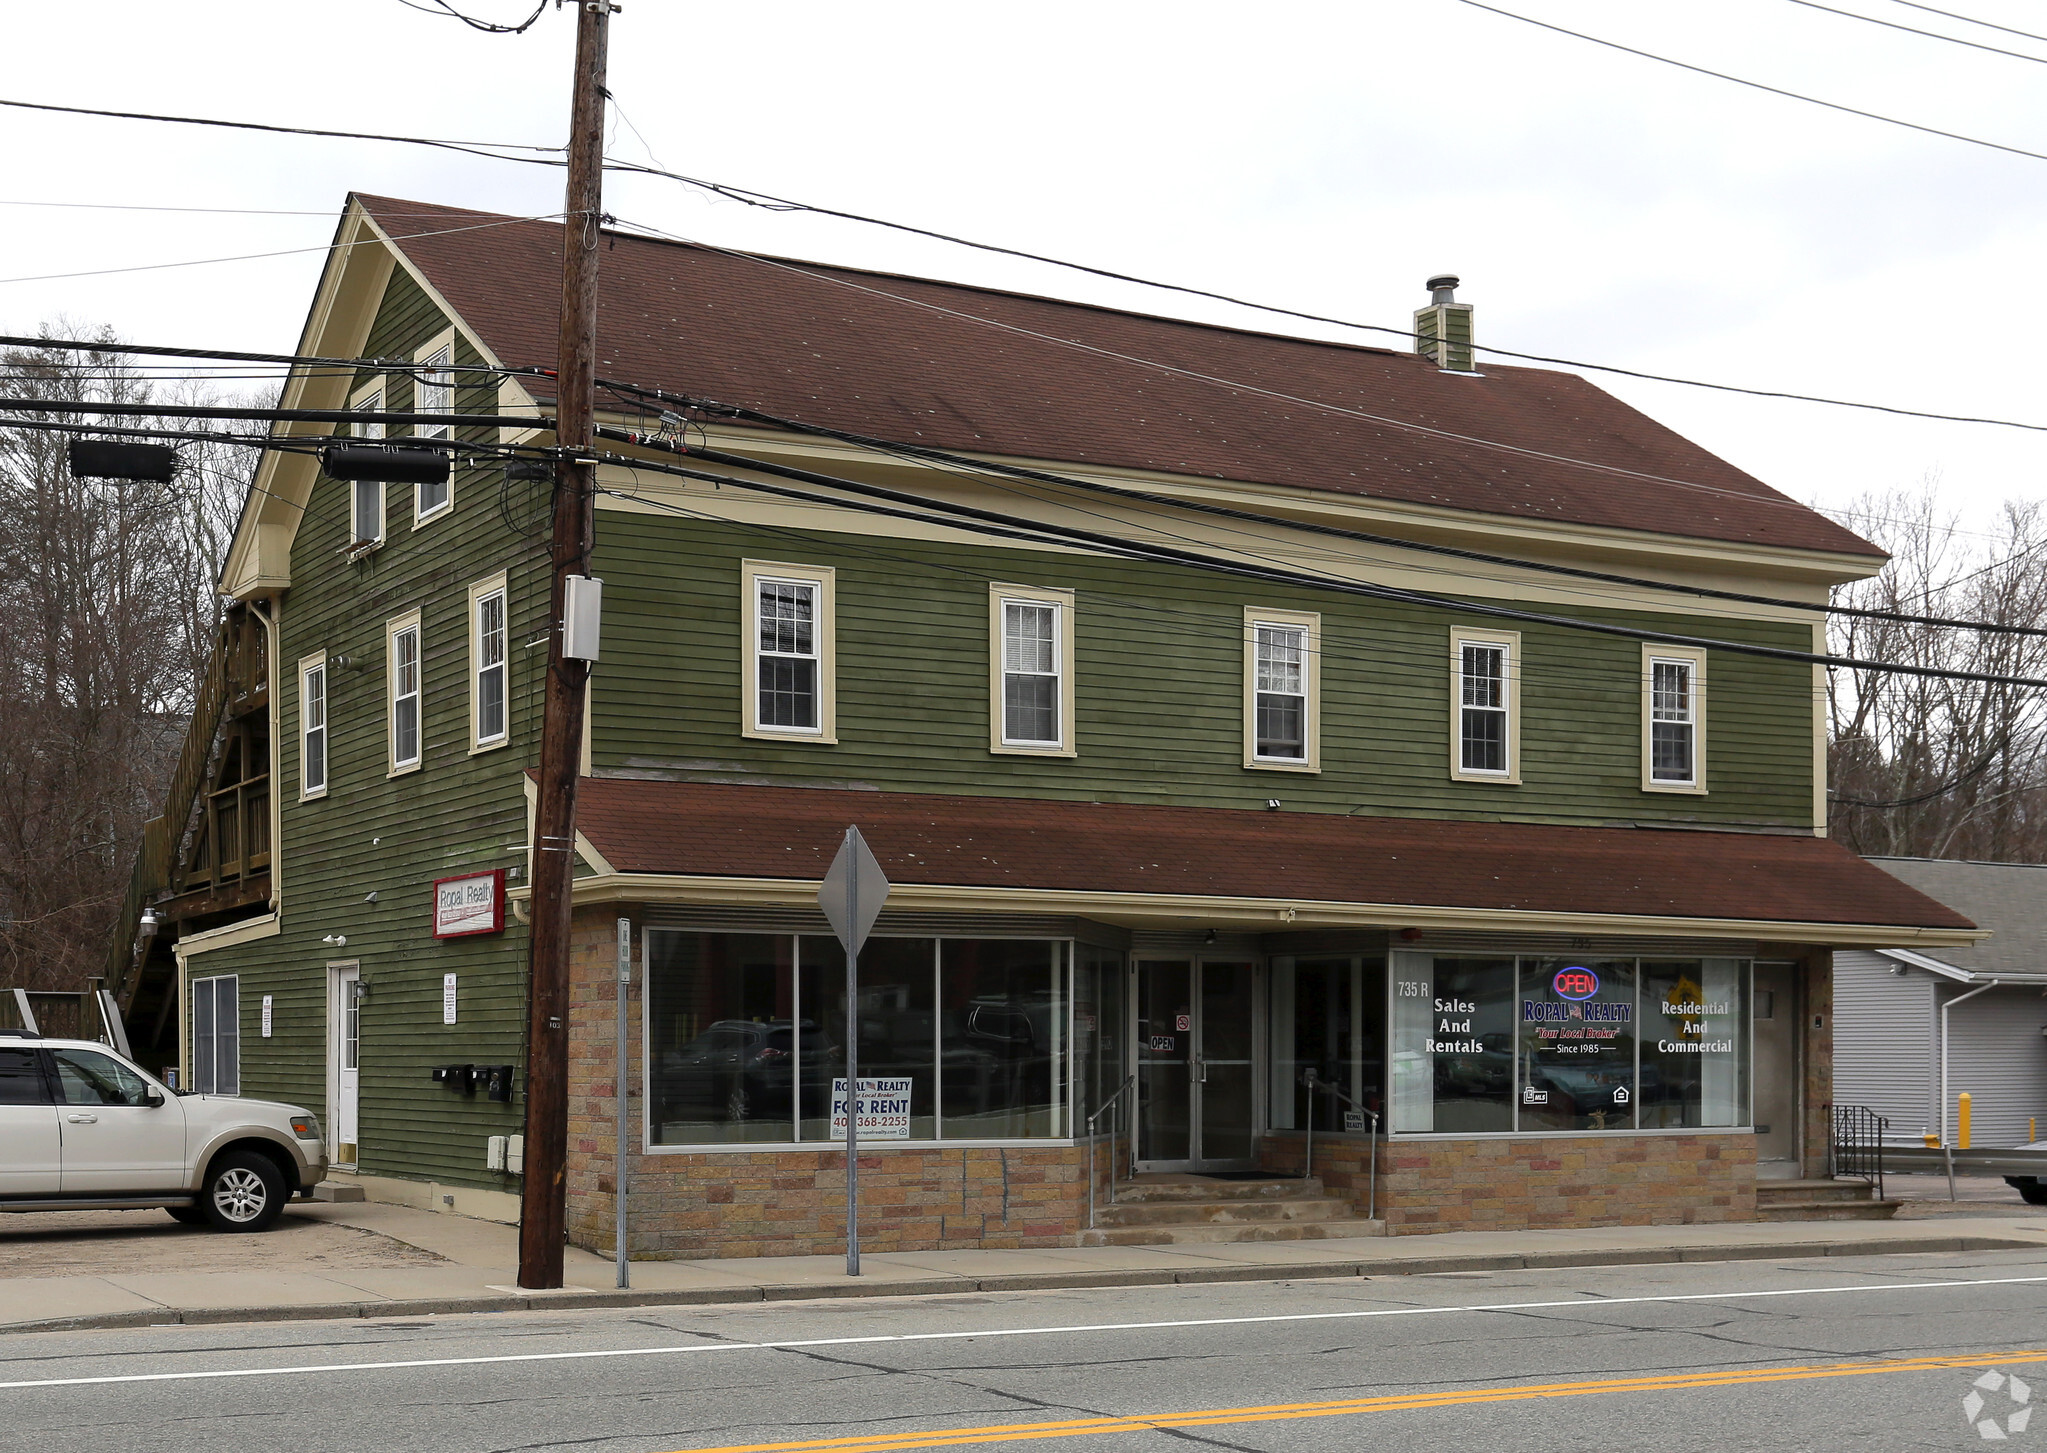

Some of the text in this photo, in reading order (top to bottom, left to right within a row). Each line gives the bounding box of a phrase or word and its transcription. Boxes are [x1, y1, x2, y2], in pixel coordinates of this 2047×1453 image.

[440, 882, 494, 910] Ropal Realty
[1398, 981, 1429, 997] 735 R
[1556, 974, 1594, 993] OPEN
[1434, 998, 1476, 1013] Sales
[1523, 1000, 1632, 1022] ROPAL REALTY
[1661, 1001, 1729, 1015] Residential
[1439, 1018, 1471, 1033] And
[1682, 1020, 1708, 1034] And
[1560, 1027, 1585, 1039] Local
[1151, 1036, 1174, 1050] OPEN
[1425, 1038, 1484, 1053] Rentals
[1557, 1043, 1599, 1054] Since 1985
[1658, 1039, 1732, 1053] Commercial
[877, 1081, 910, 1091] REALTY
[870, 1100, 908, 1113] RENT
